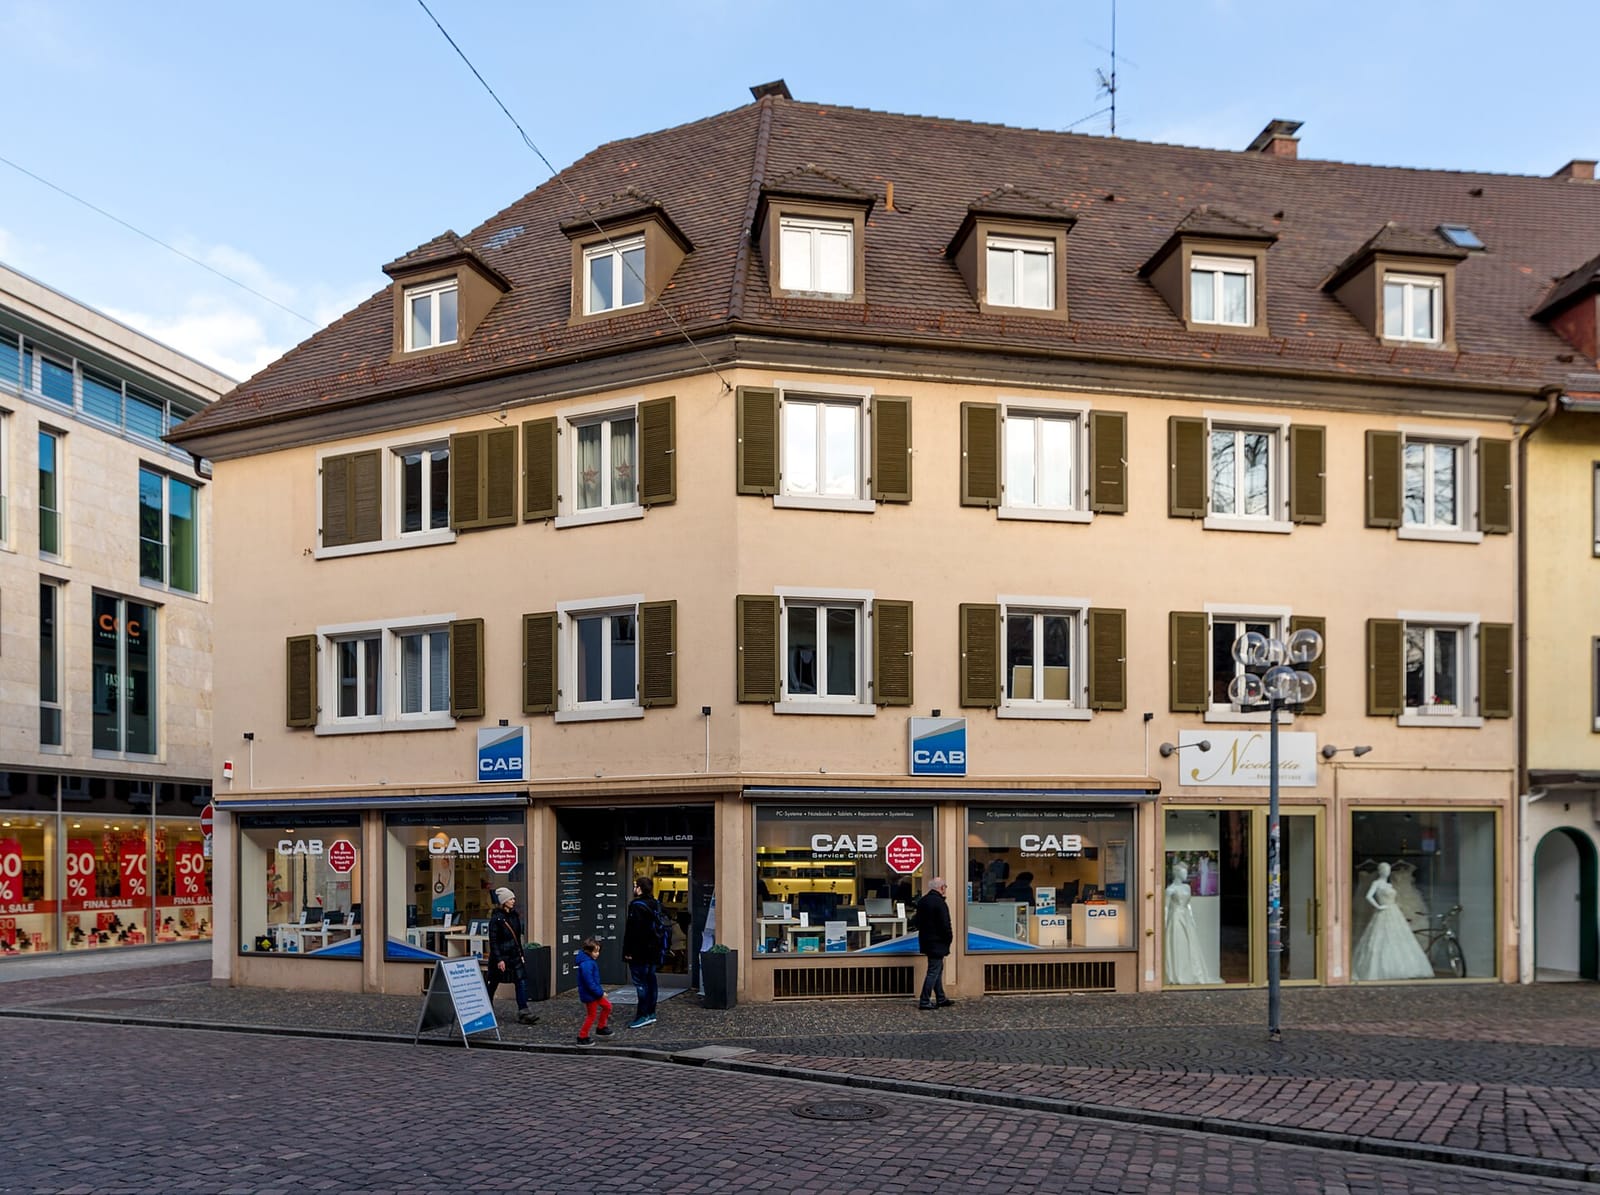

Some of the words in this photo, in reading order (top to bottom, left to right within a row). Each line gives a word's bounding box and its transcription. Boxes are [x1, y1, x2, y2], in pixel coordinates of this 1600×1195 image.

[914, 750, 964, 764] CAB
[1191, 734, 1300, 782] Nicoltta
[480, 758, 522, 771] CAB
[278, 840, 324, 854] CAB
[429, 838, 480, 854] CAB
[562, 840, 581, 850] CAB
[812, 834, 878, 852] CAB
[1020, 834, 1082, 852] CAB
[176, 854, 204, 874] -50
[83, 900, 110, 909] FINAL
[112, 899, 133, 907] SALE
[174, 896, 196, 904] FINAL
[8, 904, 34, 912] SALE
[1088, 909, 1117, 917] CAB
